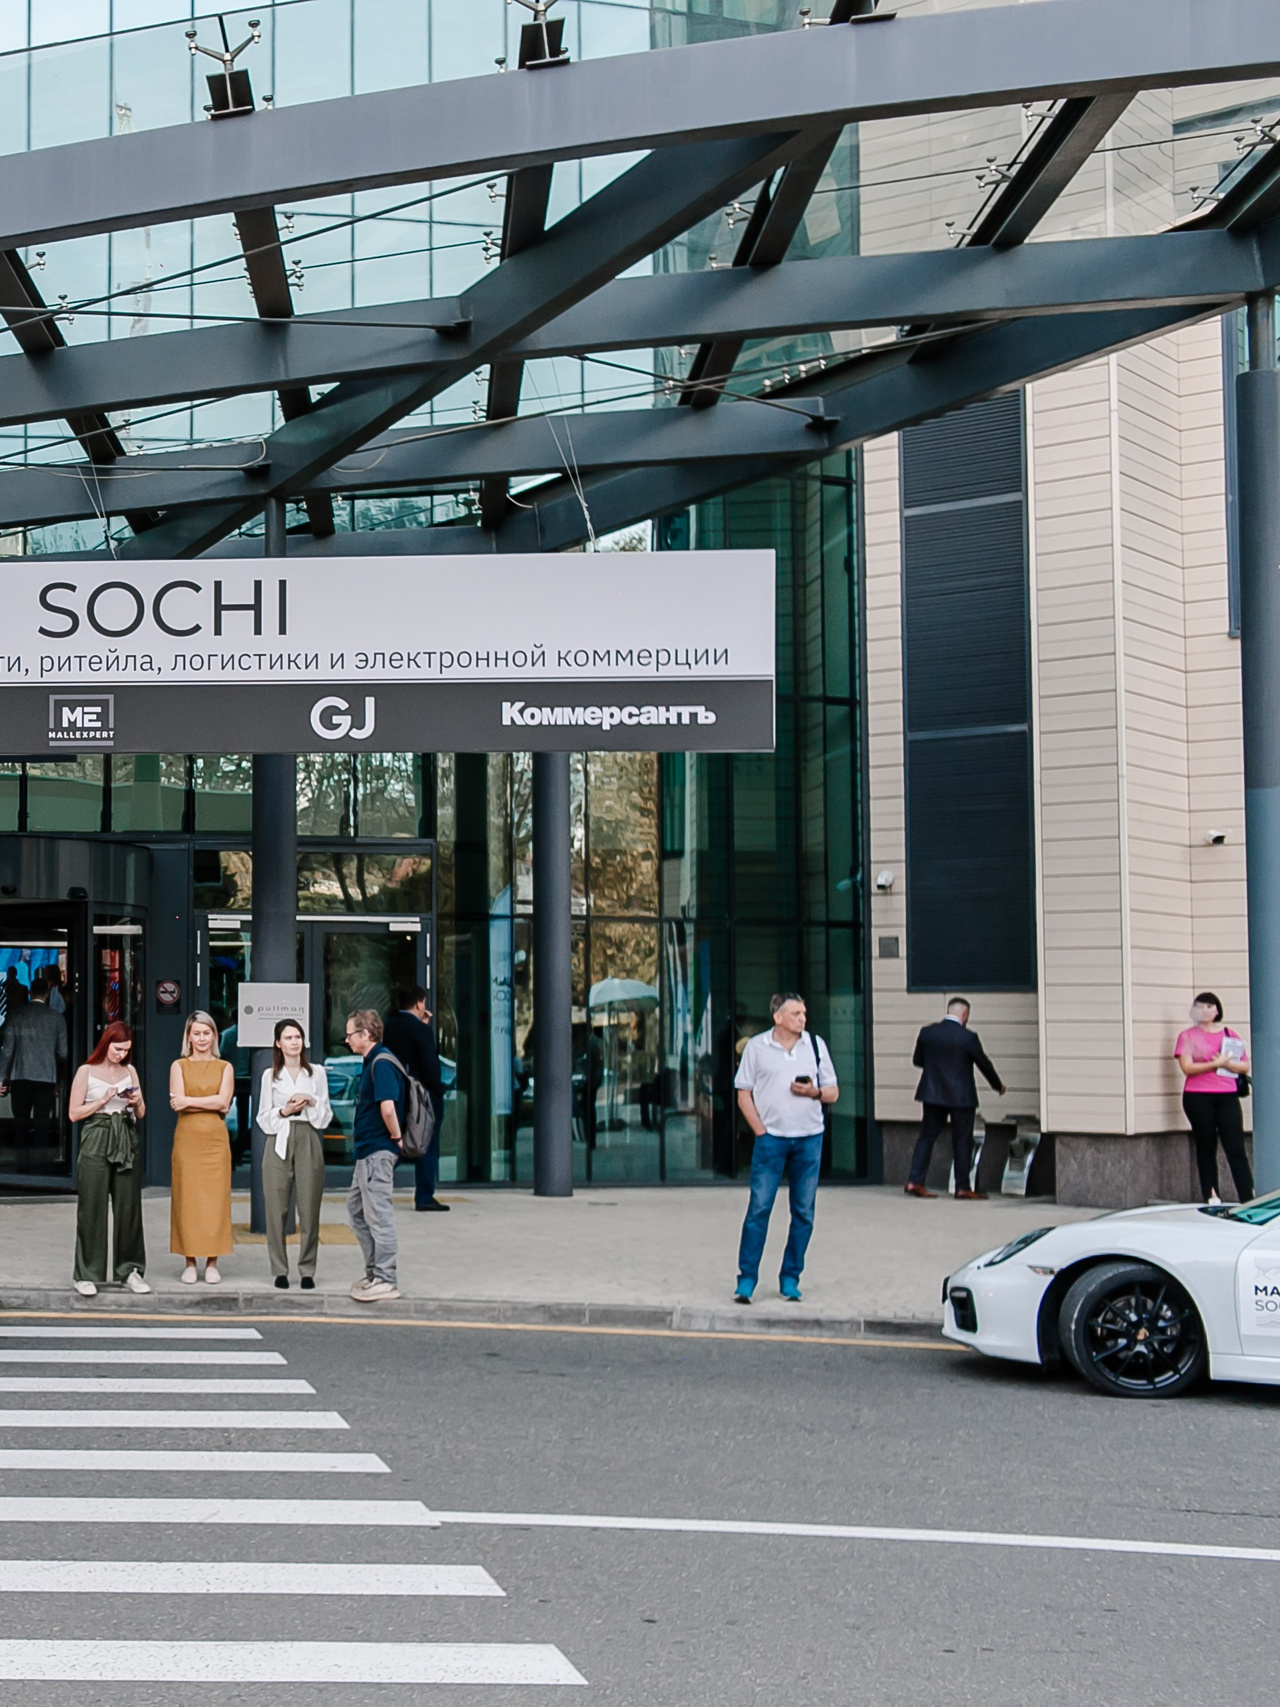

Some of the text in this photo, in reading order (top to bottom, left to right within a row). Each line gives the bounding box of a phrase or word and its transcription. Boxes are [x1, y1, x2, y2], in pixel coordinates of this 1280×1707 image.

[37, 578, 288, 640] SOCHI
[40, 648, 162, 679] ритейла,
[170, 652, 319, 672] логистики
[330, 652, 345, 670] и
[354, 643, 546, 675] электронной
[557, 647, 729, 673] коммерции
[62, 706, 103, 729] ME
[309, 696, 376, 741] GJ
[502, 701, 717, 731] Коммерсантъ
[48, 730, 116, 739] MALLEXPERT
[1254, 1299, 1280, 1312] SO
